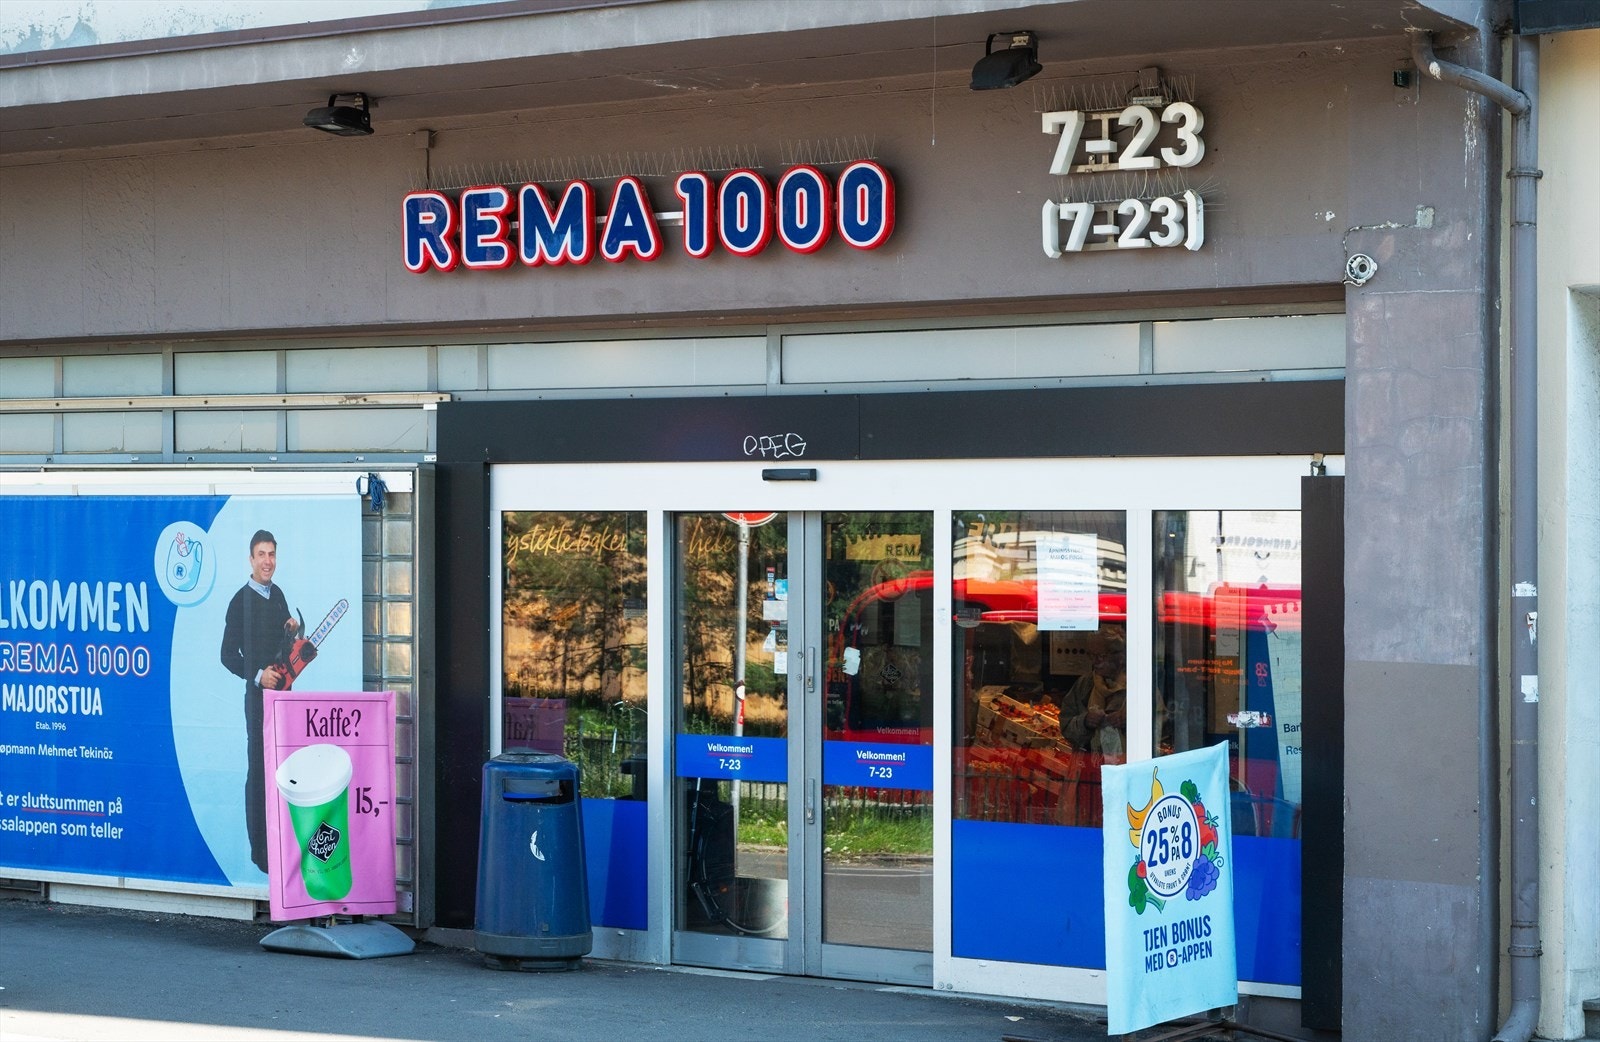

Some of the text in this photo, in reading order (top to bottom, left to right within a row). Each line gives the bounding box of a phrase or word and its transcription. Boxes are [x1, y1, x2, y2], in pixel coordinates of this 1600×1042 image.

[1042, 102, 1204, 175] 7-23
[402, 159, 896, 273] REMA 1000
[1042, 189, 1204, 258] (7-23)
[312, 621, 331, 645] REMA
[0, 641, 150, 678] REMA 1000
[2, 683, 103, 716] MAJORSTUA
[36, 721, 67, 731] Etab. 1996
[306, 708, 361, 737] Kaffe?
[877, 726, 919, 736] Velkommen!
[0, 744, 113, 760] øpmann Mehmet Tekinöz
[707, 743, 753, 754] Velkommen!
[856, 750, 906, 761] Velkommen!
[719, 759, 741, 770] 7-23
[869, 766, 893, 778] 7-23
[6, 794, 19, 807] er
[21, 791, 104, 813] sluttsummen
[108, 796, 122, 817] på
[355, 787, 388, 817] 15,-
[1157, 804, 1182, 824] BONUS
[0, 815, 124, 839] salappen som teller
[1147, 826, 1169, 868] 25
[1181, 821, 1192, 859] 8
[1143, 915, 1212, 952] TJEN BONUS
[1145, 952, 1164, 974] MED
